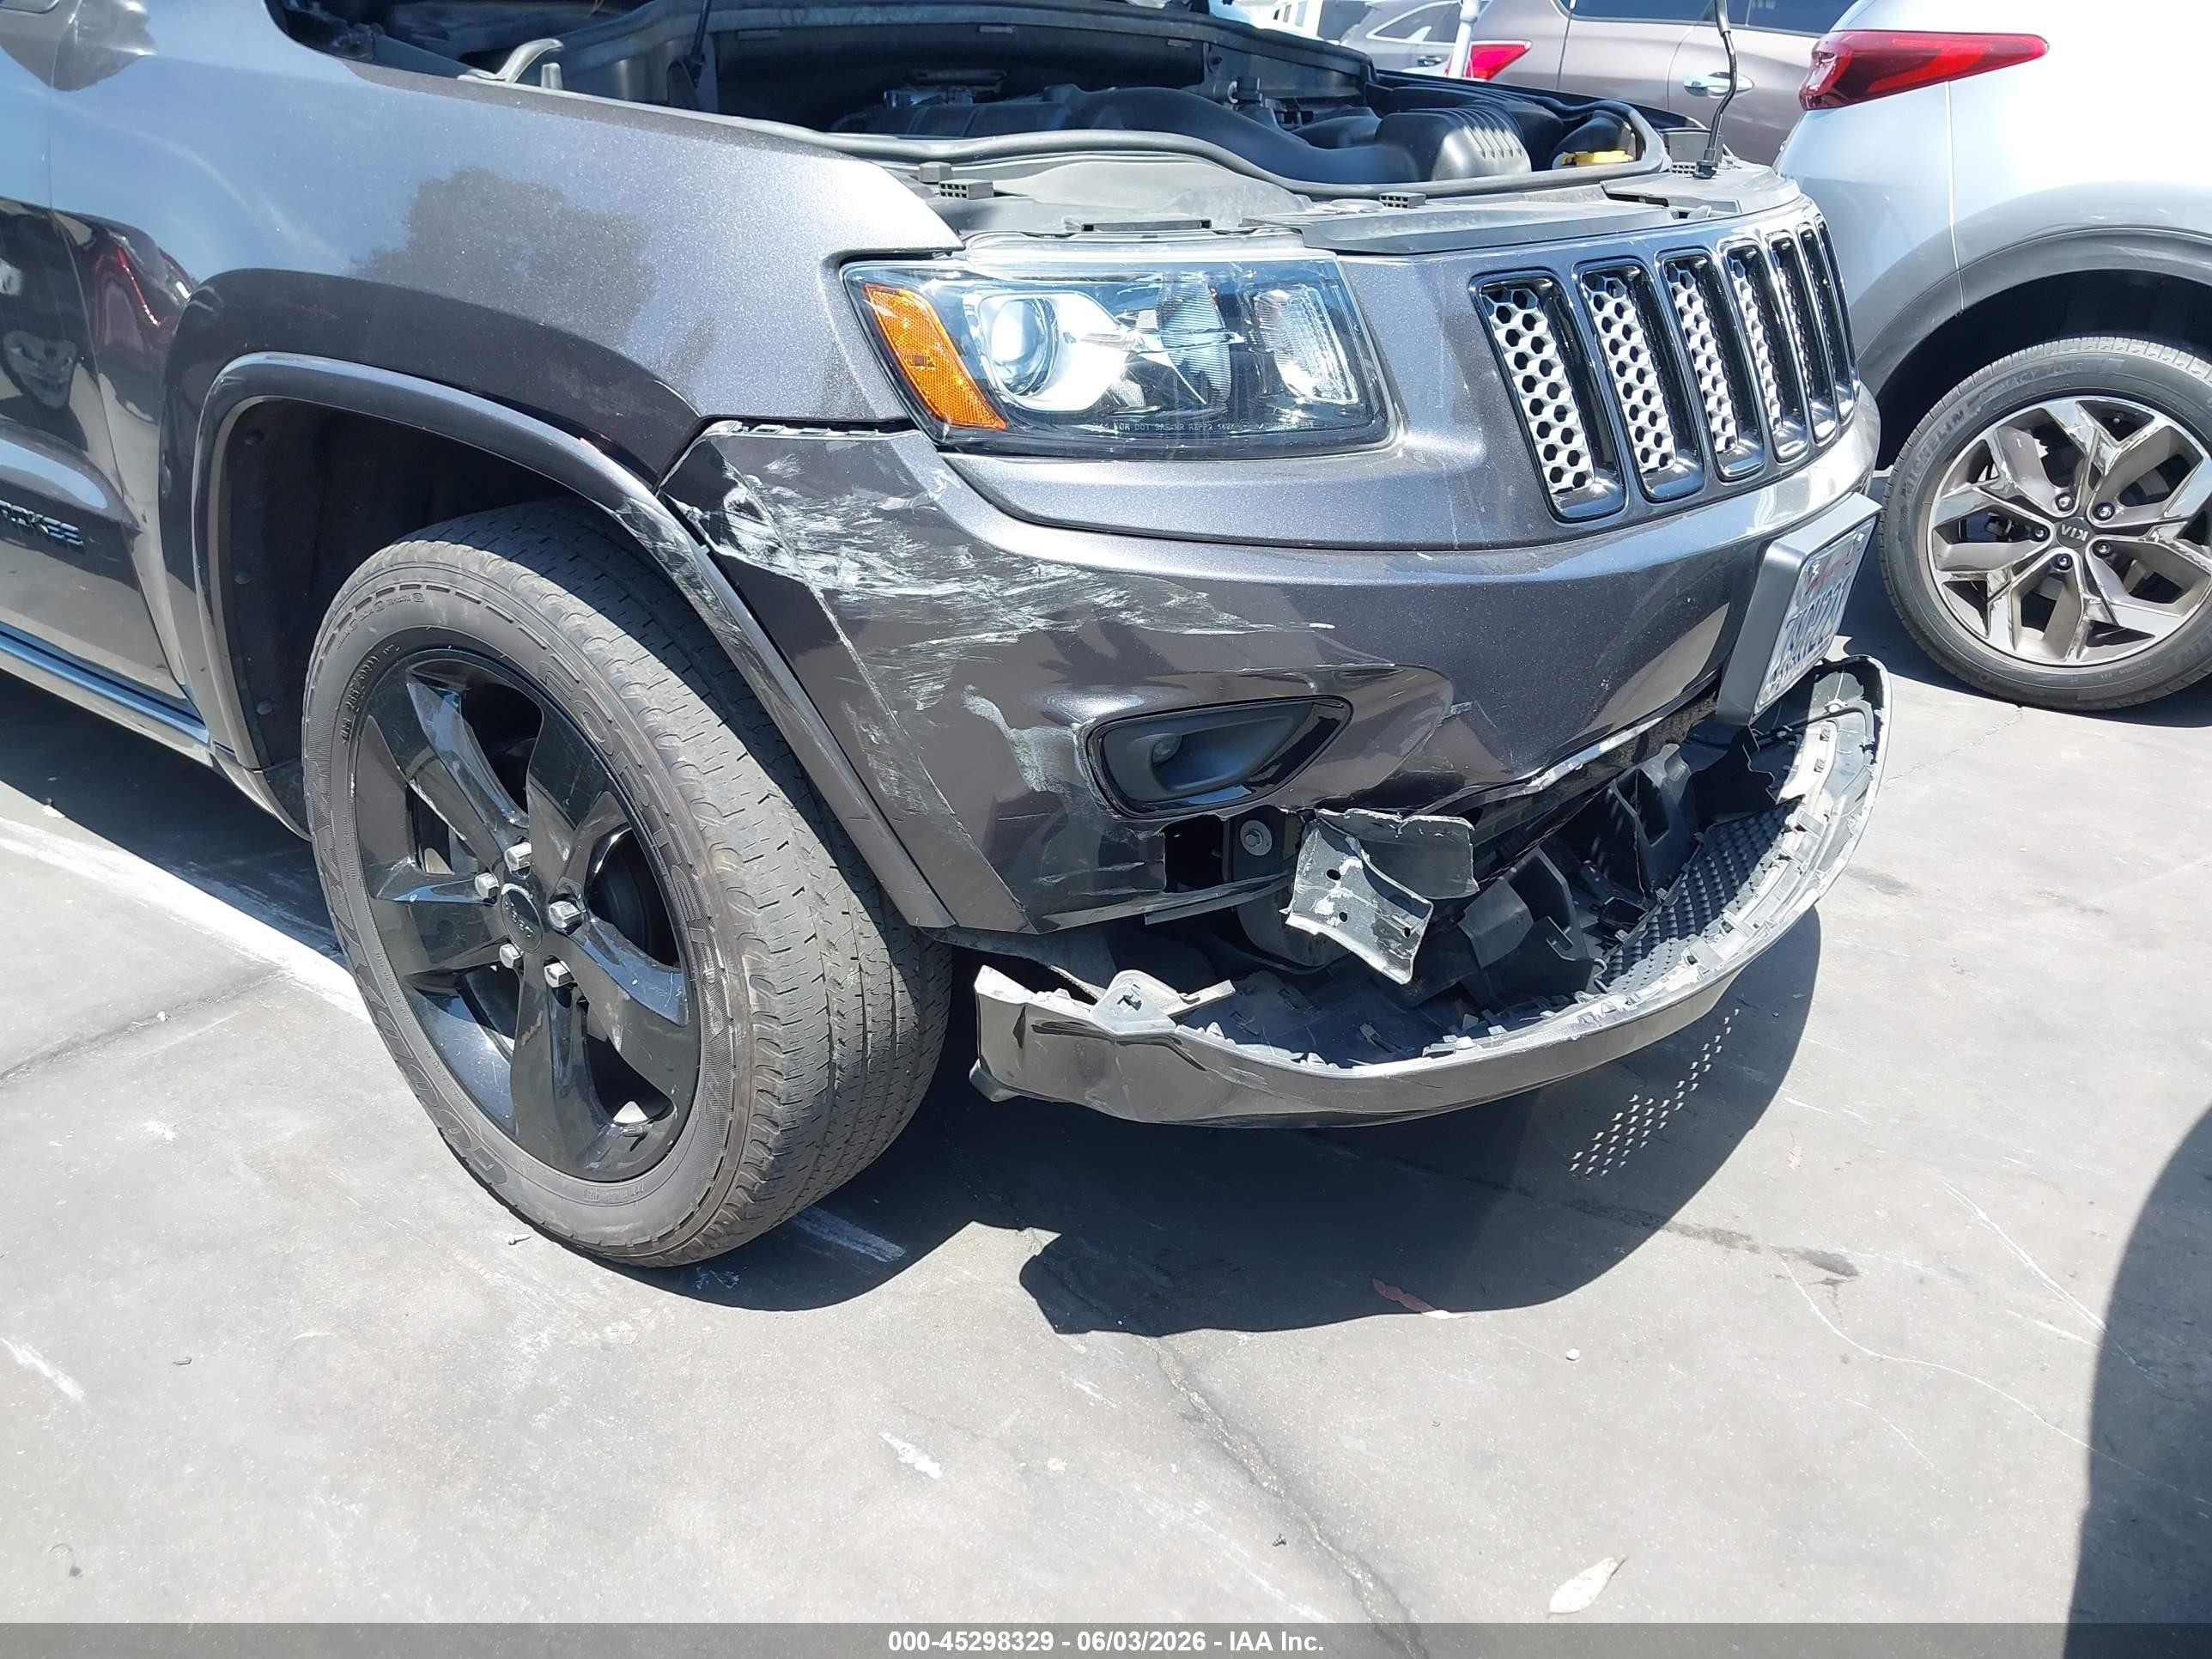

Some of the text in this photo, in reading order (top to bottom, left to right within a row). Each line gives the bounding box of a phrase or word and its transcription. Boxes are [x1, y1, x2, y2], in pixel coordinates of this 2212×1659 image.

[2062, 524, 2088, 542] KIA
[309, 761, 507, 1184] GOODYEAR
[538, 660, 724, 1043] FORTERA
